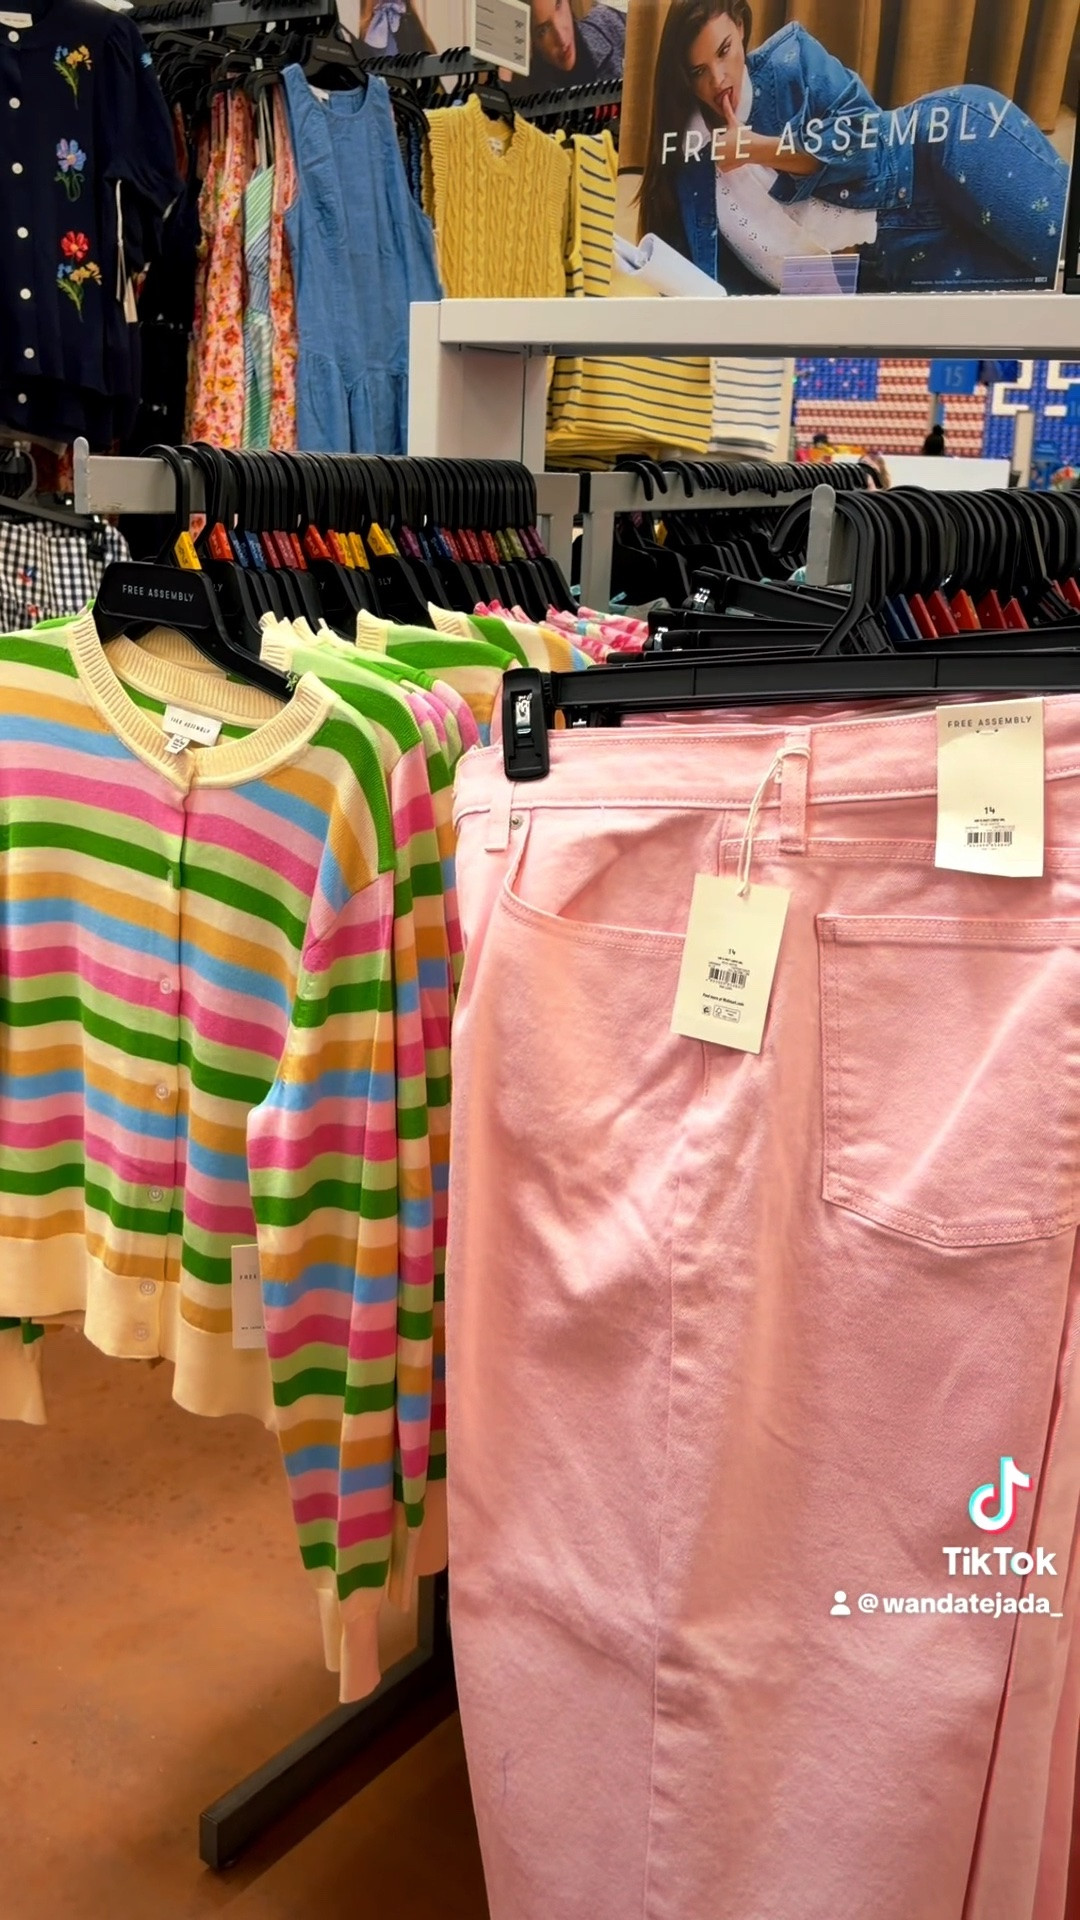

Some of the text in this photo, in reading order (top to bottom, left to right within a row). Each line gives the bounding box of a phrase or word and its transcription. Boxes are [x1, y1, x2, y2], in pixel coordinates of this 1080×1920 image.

[661, 100, 1013, 165] FREE ASSEMBLY
[945, 366, 963, 388] 15
[122, 584, 194, 602] FREE ASSEMBLY
[947, 715, 1032, 728] FREE ASSEMBLY
[984, 806, 995, 814] 14
